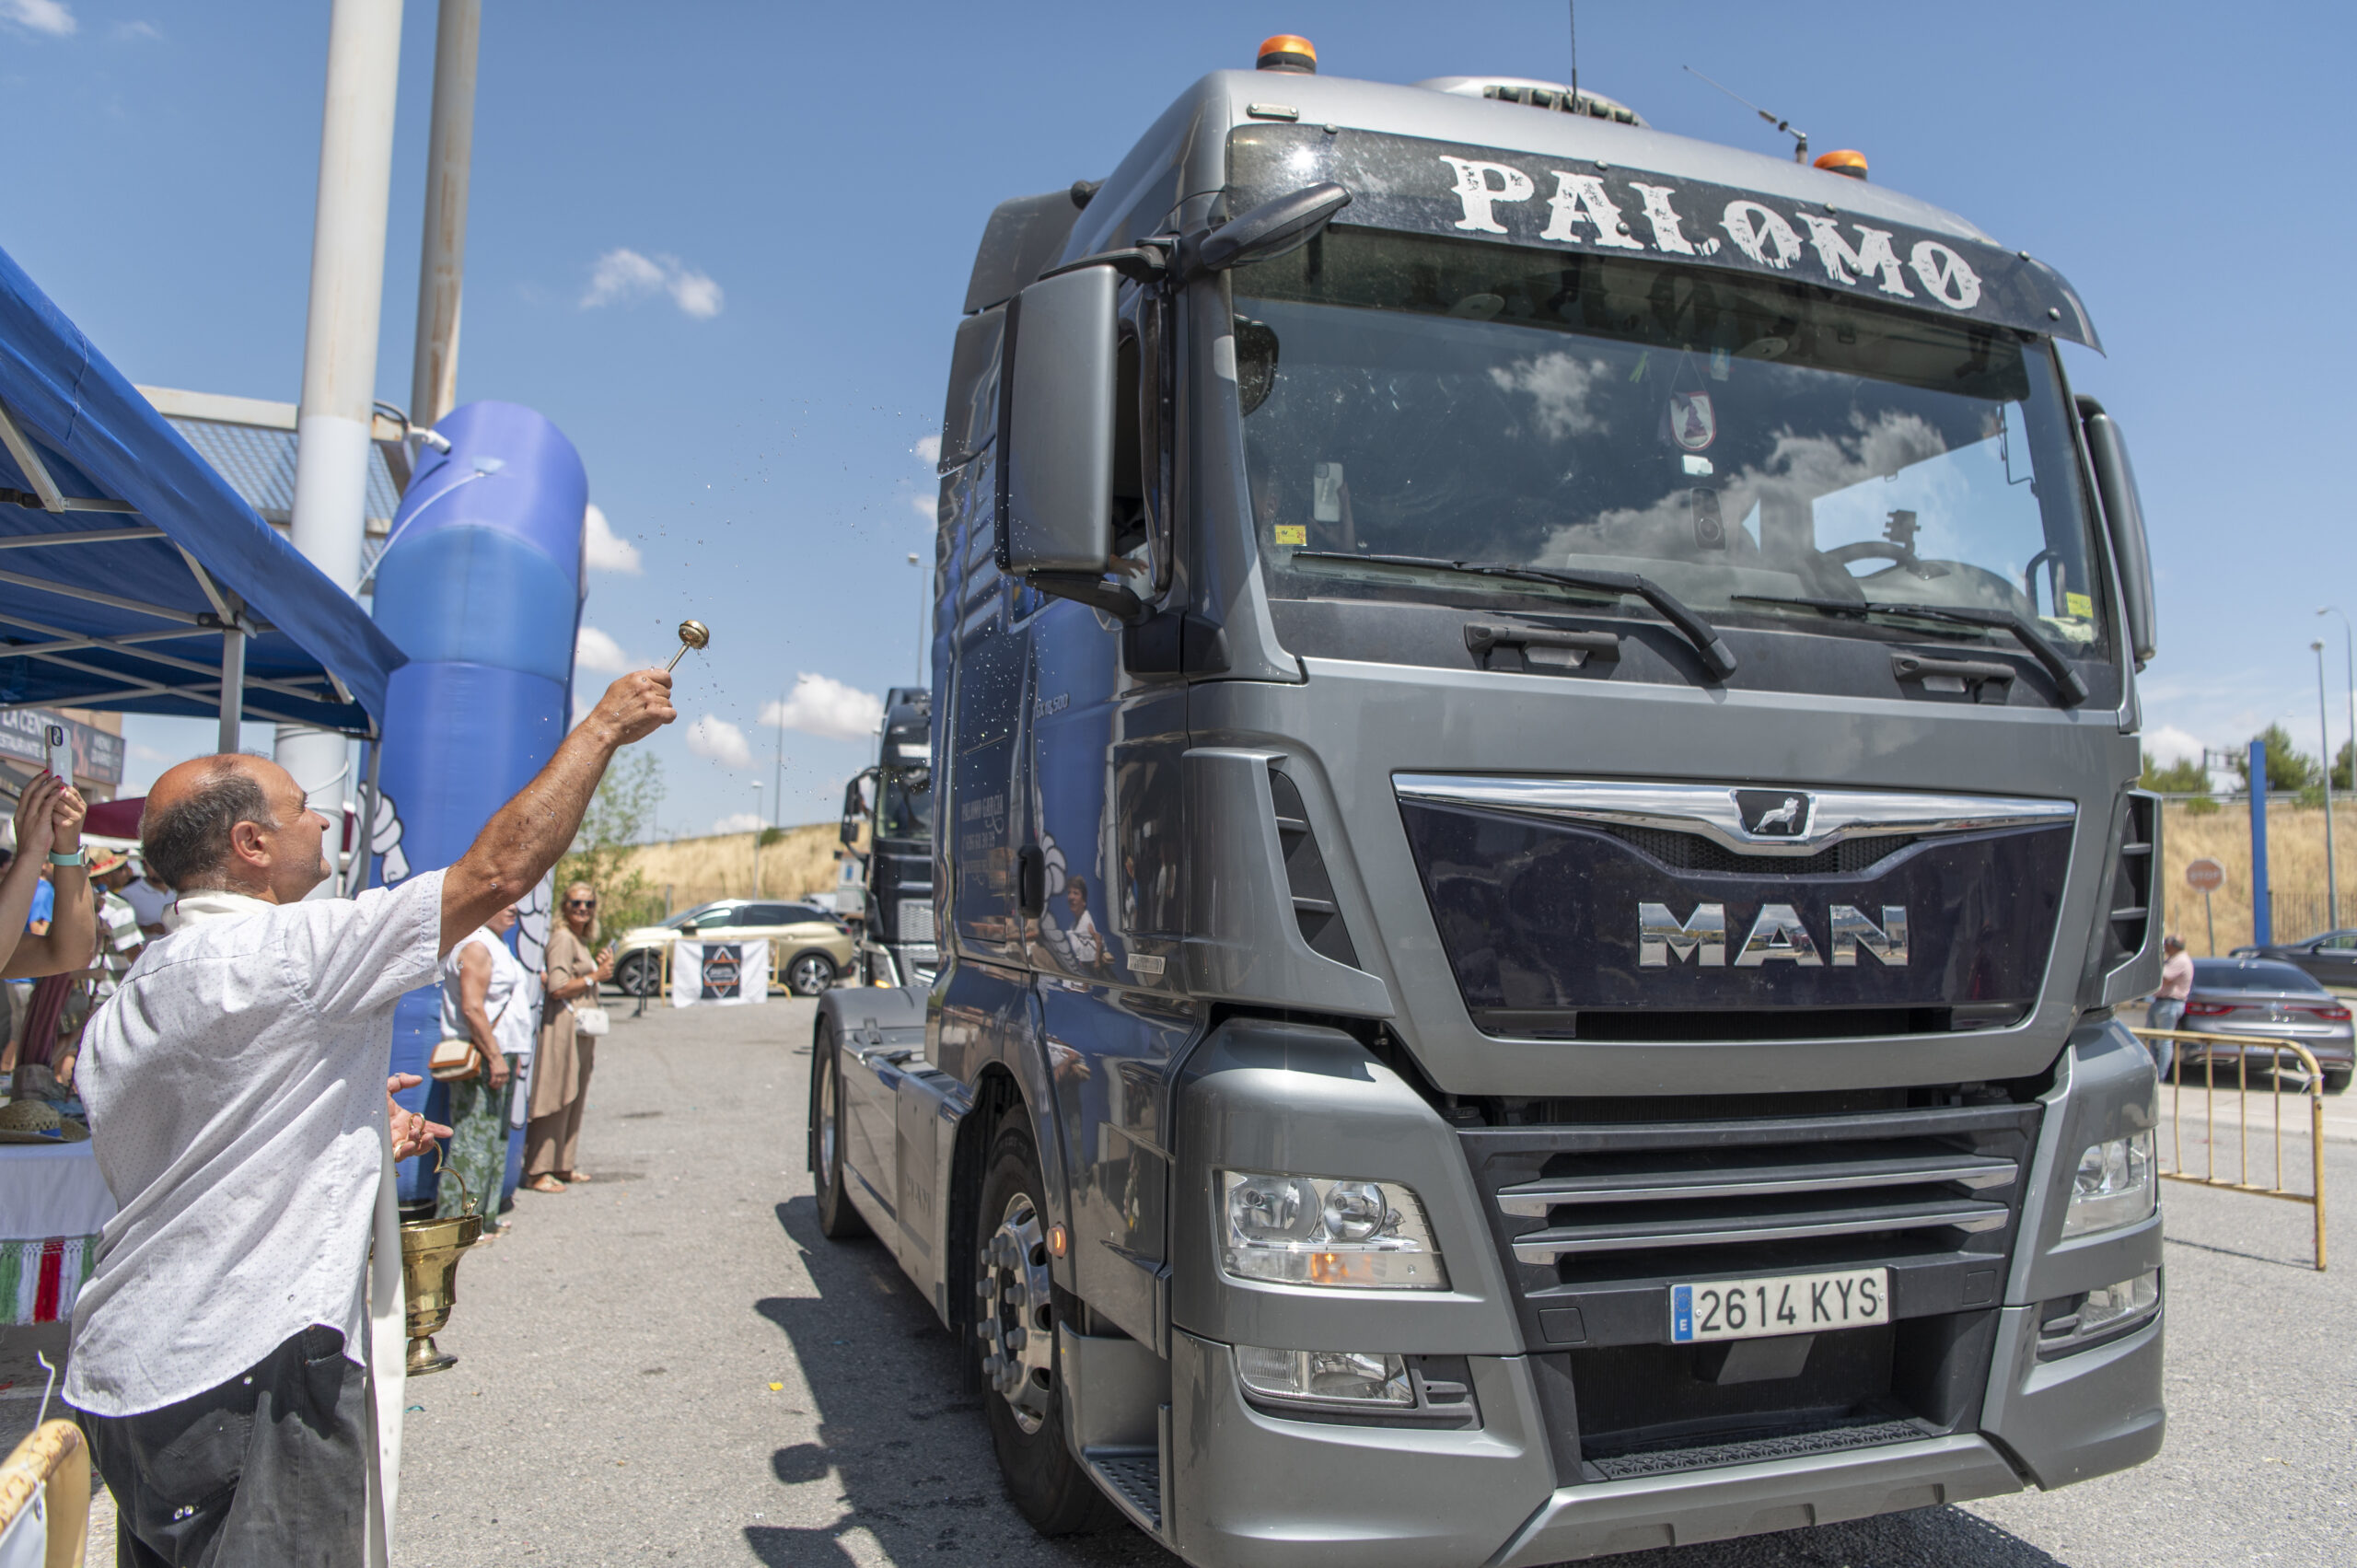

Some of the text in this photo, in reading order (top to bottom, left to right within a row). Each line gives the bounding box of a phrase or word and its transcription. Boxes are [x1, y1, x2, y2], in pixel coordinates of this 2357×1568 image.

[2190, 870, 2220, 881] STOP
[1638, 901, 1910, 967] MAN
[1679, 1277, 1878, 1332] E 2614 KYS
